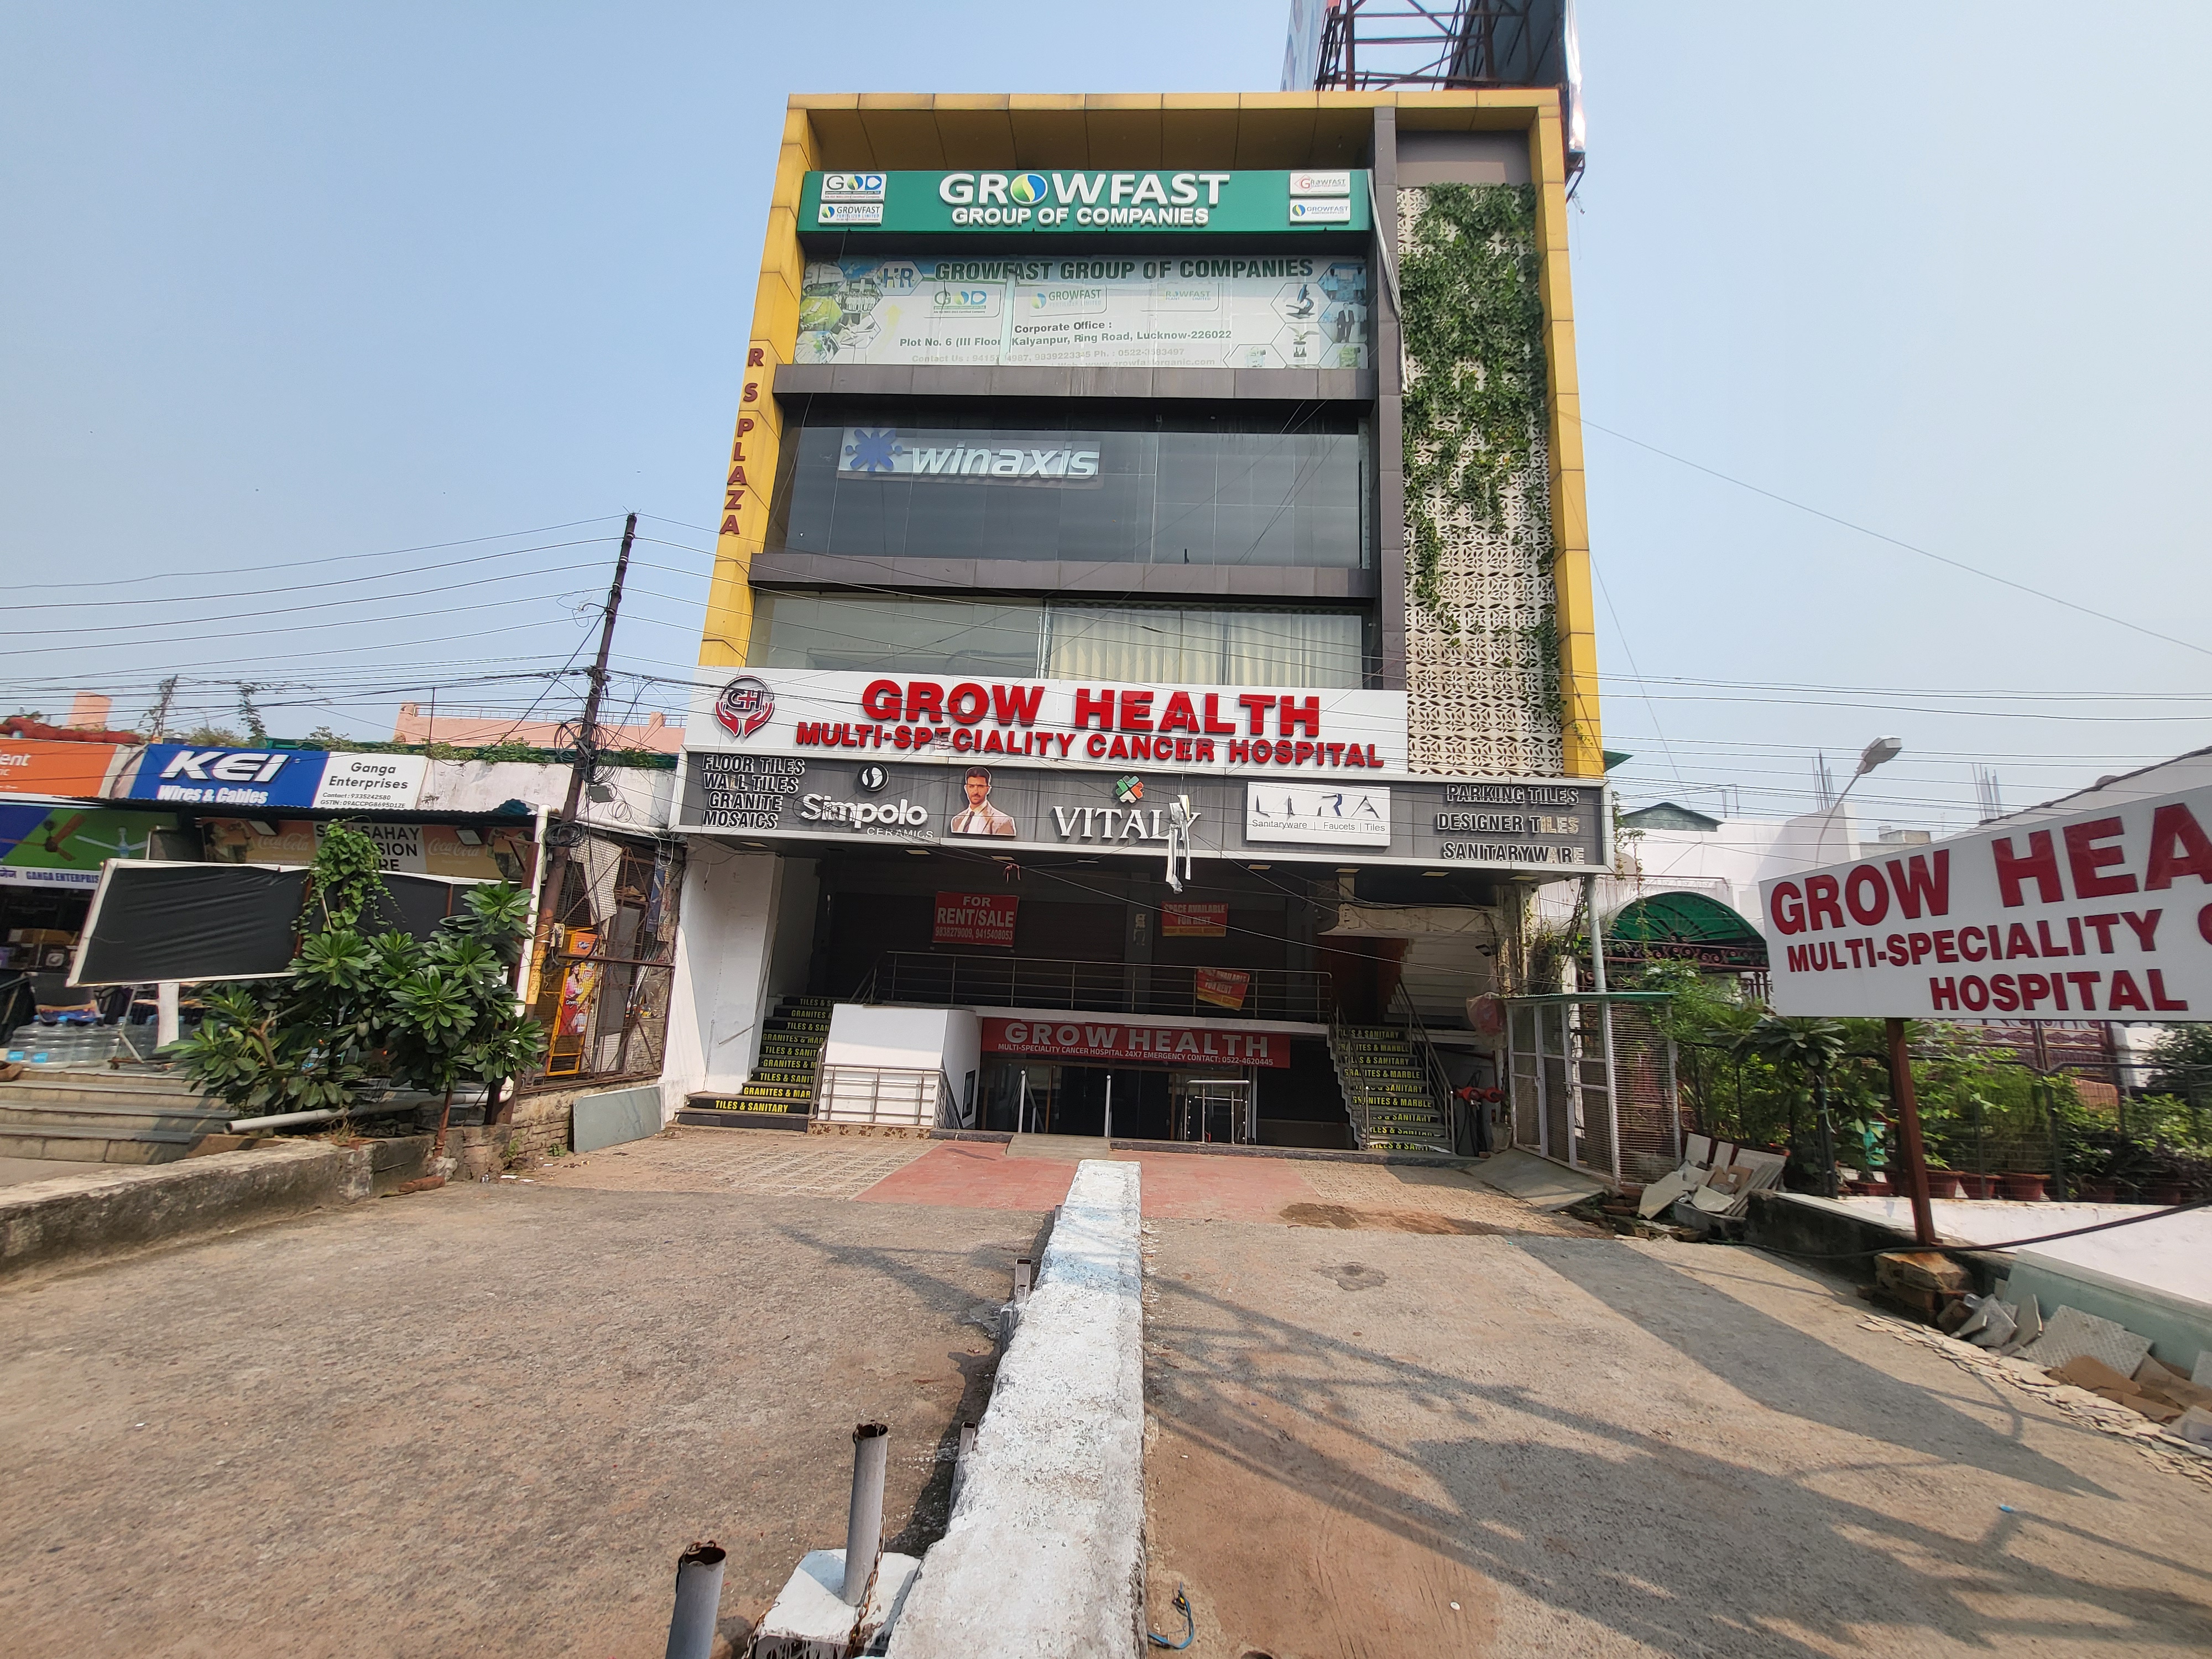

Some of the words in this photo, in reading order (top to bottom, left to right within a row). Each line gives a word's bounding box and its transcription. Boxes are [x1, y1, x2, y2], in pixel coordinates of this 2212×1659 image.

[940, 172, 1230, 208] GROWFAST
[952, 206, 1032, 227] GROUP
[1038, 207, 1070, 226] OF
[1077, 207, 1209, 227] COMPANIES
[935, 262, 1053, 280] GROWFAST
[1060, 261, 1135, 279] GROUP
[1142, 260, 1172, 279] OF
[1180, 258, 1314, 278] COMPANIES
[1048, 289, 1102, 301] GROWFAST
[1014, 322, 1070, 334] Corporate
[1073, 321, 1105, 330] Office
[900, 338, 921, 346] Plot
[925, 338, 942, 346] No.
[1012, 336, 1071, 347] Kalyanpur,
[1074, 334, 1098, 343] Ring
[1101, 332, 1133, 342] Road,
[1136, 330, 1232, 340] Lucknow-226022
[747, 348, 764, 367] R
[743, 382, 758, 402] S
[912, 440, 1099, 479] winaxis
[719, 418, 754, 535] PLAZA
[862, 679, 1045, 727] GROW
[1074, 687, 1320, 738] HEALTH
[796, 721, 1077, 757] MULTI-SPECIALITY
[1087, 733, 1215, 762] CANCER
[1228, 738, 1385, 769] HOSPITAL
[159, 750, 291, 783] KEI
[351, 761, 397, 776] Ganga
[701, 753, 755, 774] FLOOR
[759, 756, 806, 776] TILES
[328, 775, 409, 791] Enterprises
[703, 772, 748, 792] WALL
[752, 775, 800, 795] TILES
[201, 788, 215, 803] &
[216, 787, 269, 805] Cables
[708, 791, 784, 812] GRANITE
[1446, 784, 1524, 804] PARKING
[1527, 786, 1579, 806] TILES
[800, 792, 929, 829] Simpolo
[702, 810, 779, 830] MOSAICS
[1251, 819, 1308, 830] Sanitaryware
[1323, 822, 1356, 831] Faucets
[1364, 823, 1386, 832] Tiles
[1437, 812, 1525, 833] DESIGNER
[1528, 815, 1580, 834] TILES
[361, 826, 420, 841] SAHAY
[867, 826, 935, 839] CERAMICS
[1442, 841, 1585, 865] SANITARYWARE
[26, 870, 54, 881] GANGA
[1770, 848, 1950, 937] GROW
[963, 896, 992, 907] FOR
[1164, 903, 1187, 912] SPACE
[1187, 904, 1225, 914] AVAILABLE
[937, 907, 1015, 928] RENT/SALE
[1177, 916, 1192, 926] FOR
[1193, 916, 1212, 926] RENT
[1786, 908, 2163, 973] MULTI-SPECIALITY
[1217, 982, 1233, 995] RENT
[1928, 968, 2189, 1011] HOSPITAL
[800, 998, 818, 1006] TILES
[791, 1009, 826, 1019] GRANITES
[787, 1022, 806, 1031] TILES
[808, 1022, 813, 1031] &
[1364, 1029, 1399, 1040] SANITARY
[763, 1032, 798, 1043] GRANITES
[1004, 1022, 1118, 1049] GROW
[1128, 1029, 1267, 1058] HEALTH
[765, 1045, 786, 1055] TILES
[786, 1046, 793, 1056] &
[998, 1043, 1061, 1053] MULTI-SPECIALITY
[1061, 1046, 1089, 1055] CANCER
[1089, 1048, 1124, 1057] HOSPITAL
[1143, 1051, 1186, 1061] EMERGENCY
[1187, 1054, 1221, 1063] CONTACT:
[1222, 1056, 1274, 1066] 0522-4620445
[1373, 1044, 1379, 1052] &
[763, 1058, 801, 1069] GRANITES
[802, 1060, 808, 1069] &
[1373, 1057, 1409, 1066] SANITARY
[760, 1072, 781, 1082] TILES
[782, 1073, 789, 1083] &
[1383, 1070, 1388, 1078] &
[1390, 1070, 1420, 1079] MARBLE
[743, 1087, 783, 1098] GRANITES
[785, 1088, 791, 1098] &
[1385, 1084, 1423, 1094] SANITARY
[715, 1099, 738, 1110] TILES
[739, 1101, 745, 1111] &
[747, 1102, 789, 1113] SANITARY
[1352, 1095, 1391, 1105] GRNITES
[1392, 1097, 1398, 1105] &
[1400, 1098, 1432, 1108] MARBLE
